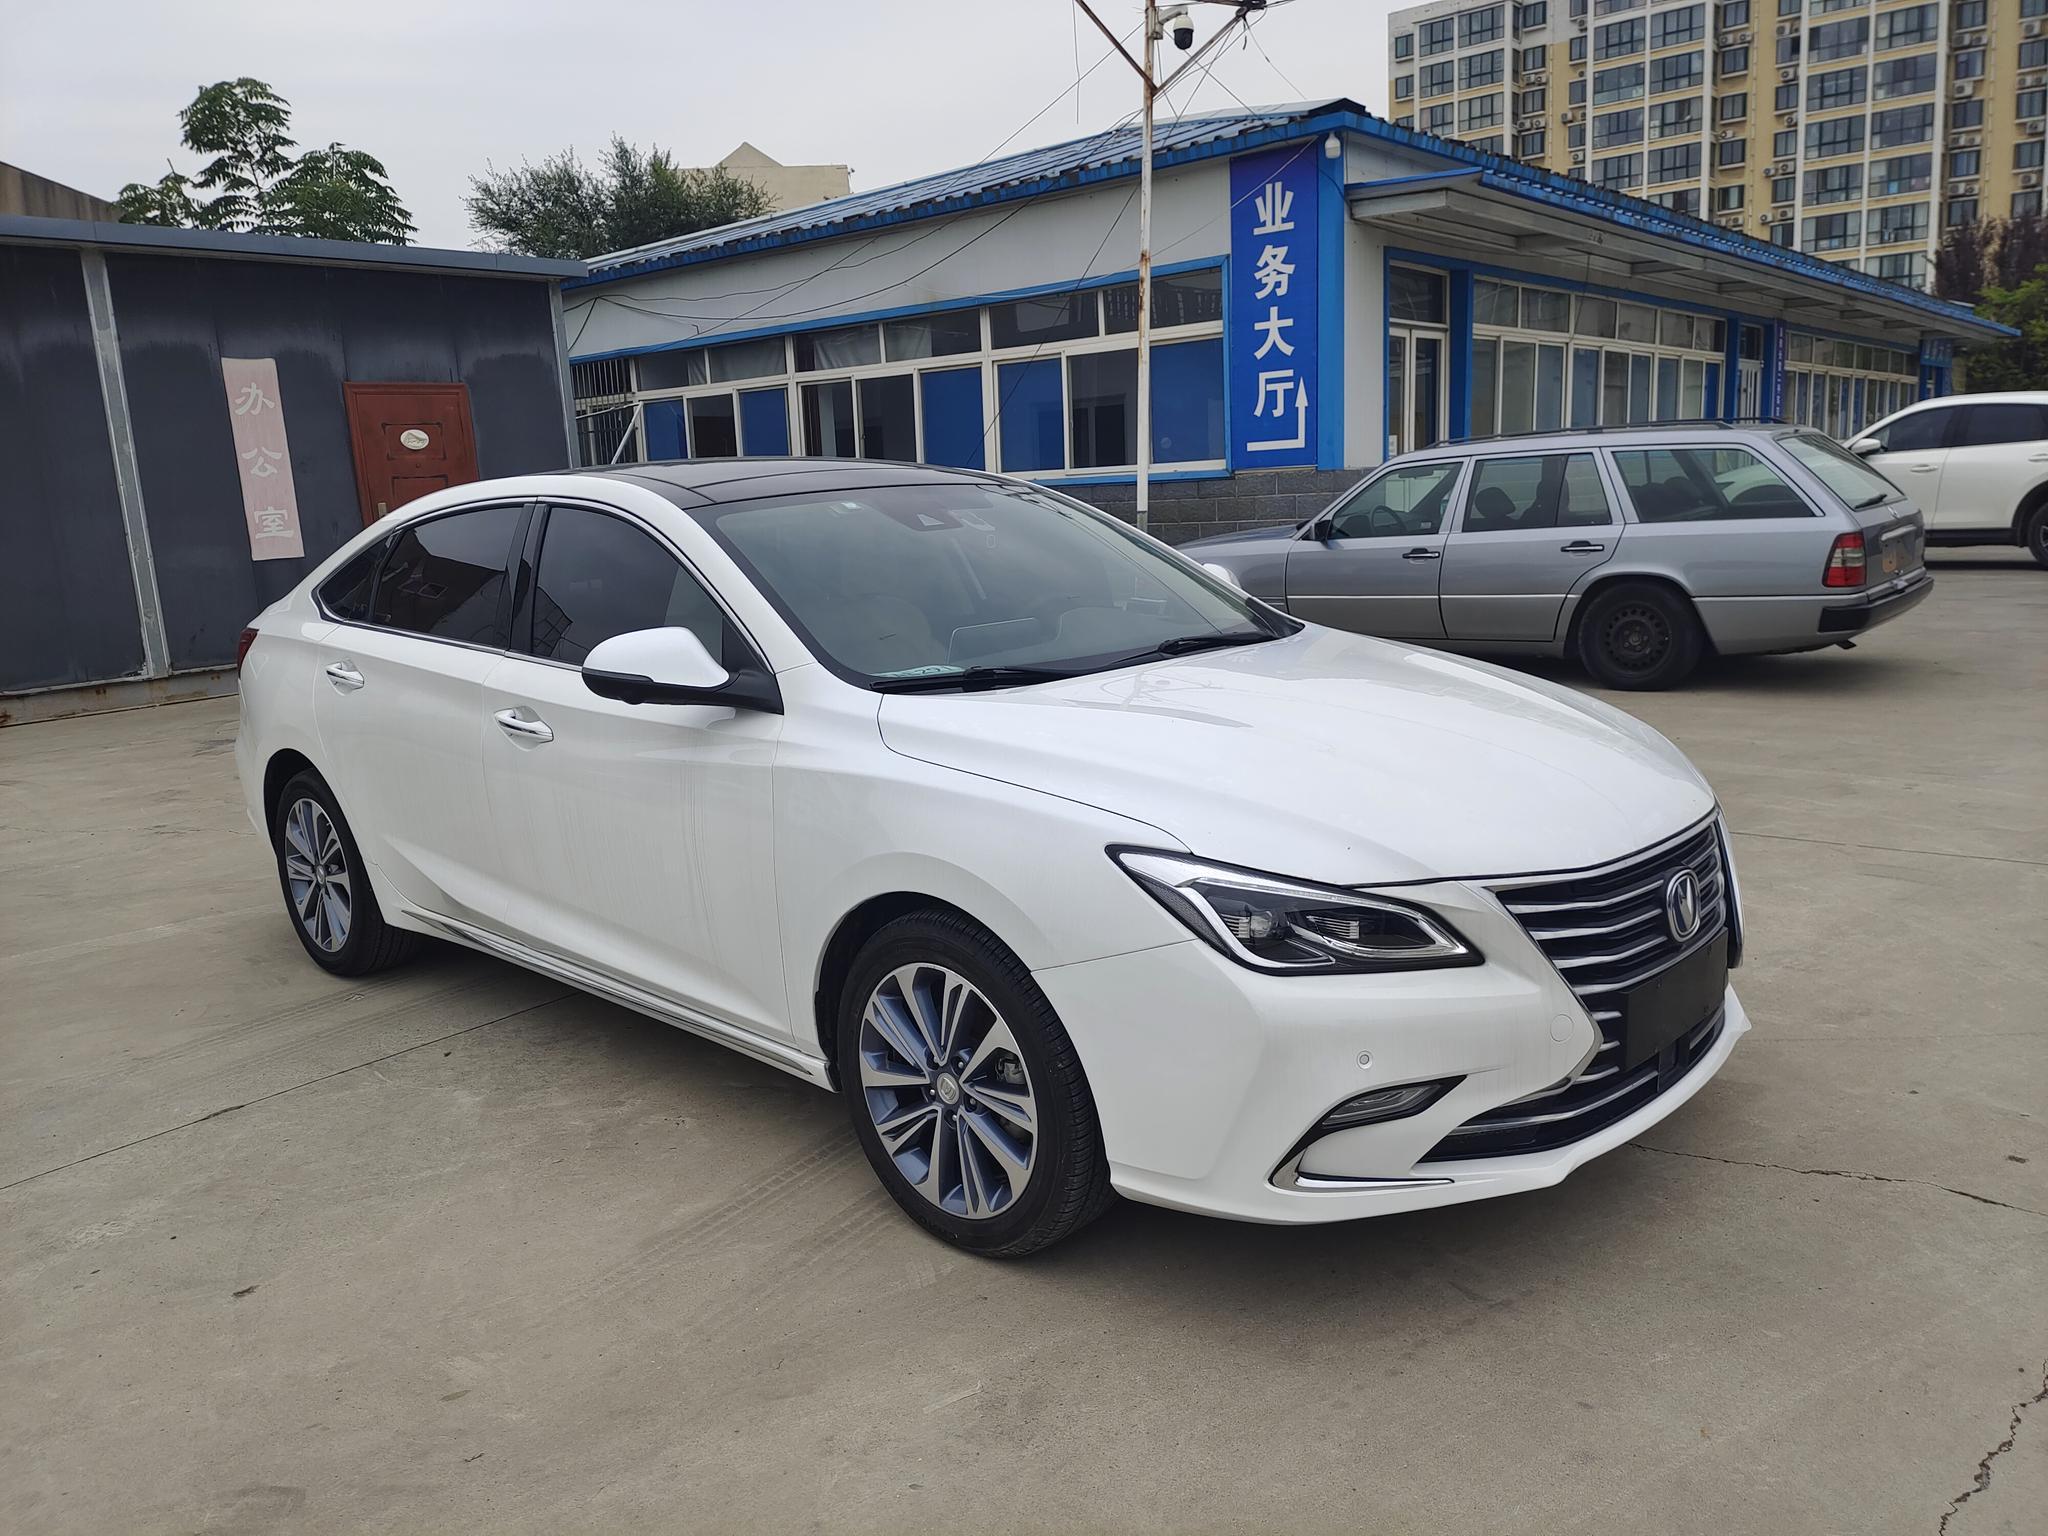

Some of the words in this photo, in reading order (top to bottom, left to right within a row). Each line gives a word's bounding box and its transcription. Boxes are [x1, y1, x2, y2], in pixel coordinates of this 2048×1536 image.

[1253, 181, 1296, 418] 业务大厅
[234, 382, 295, 540] 办公室
